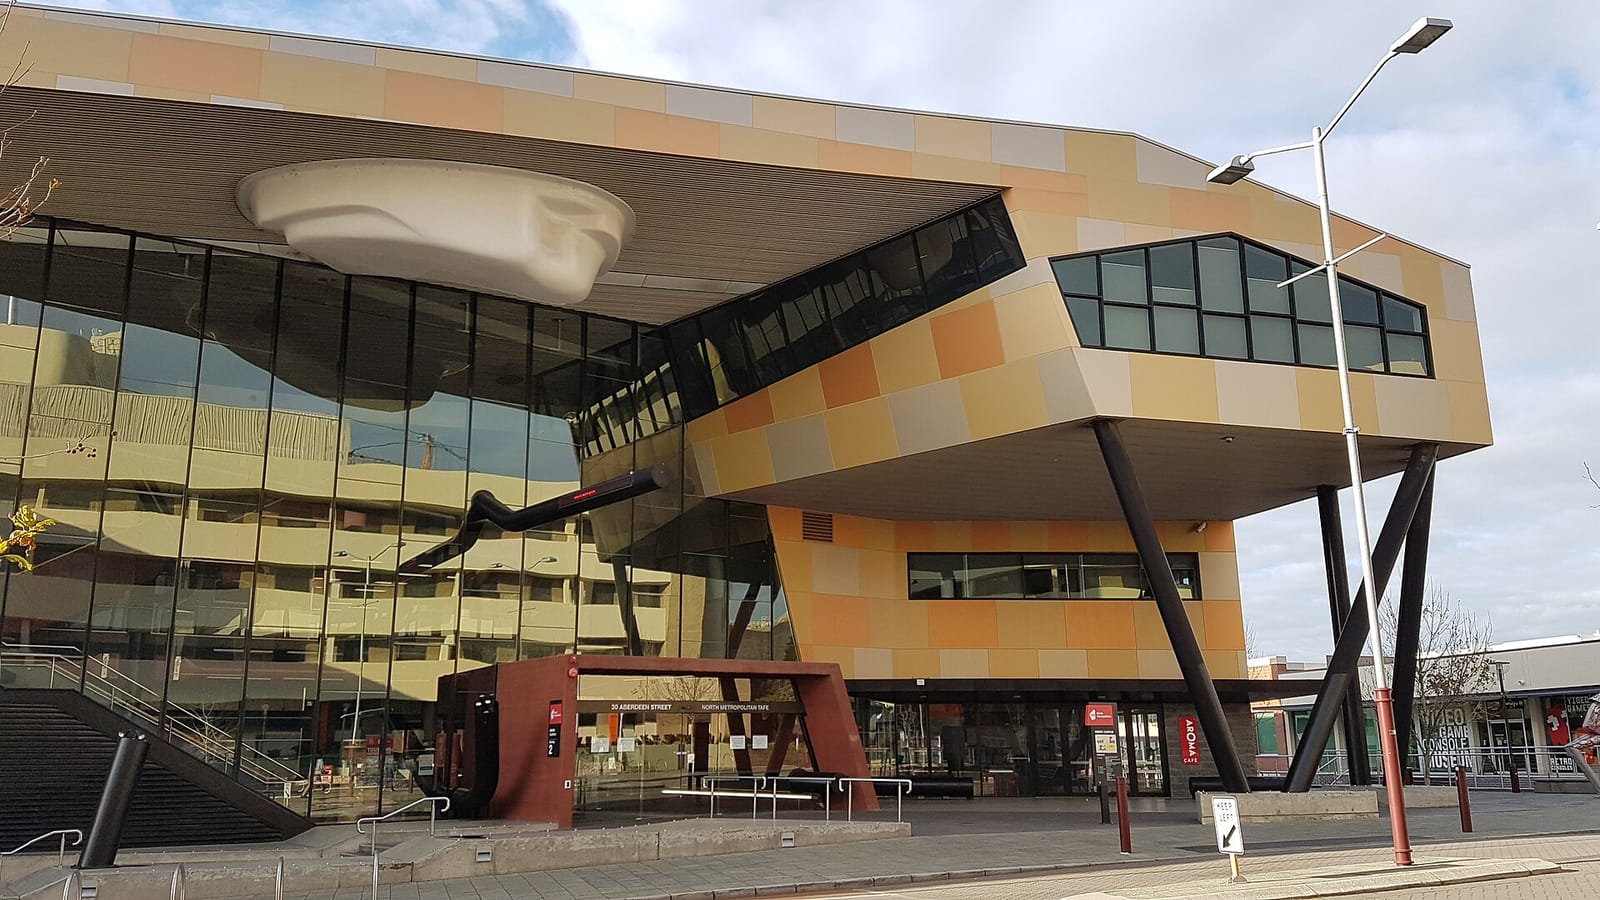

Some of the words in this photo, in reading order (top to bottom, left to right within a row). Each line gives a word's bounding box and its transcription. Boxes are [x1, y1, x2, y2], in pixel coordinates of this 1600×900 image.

[1185, 719, 1196, 757] AROMA
[1422, 738, 1468, 751] CONSOLE
[1550, 757, 1573, 766] RETRO
[1216, 802, 1232, 811] KEEP
[1218, 813, 1233, 823] LEFT
